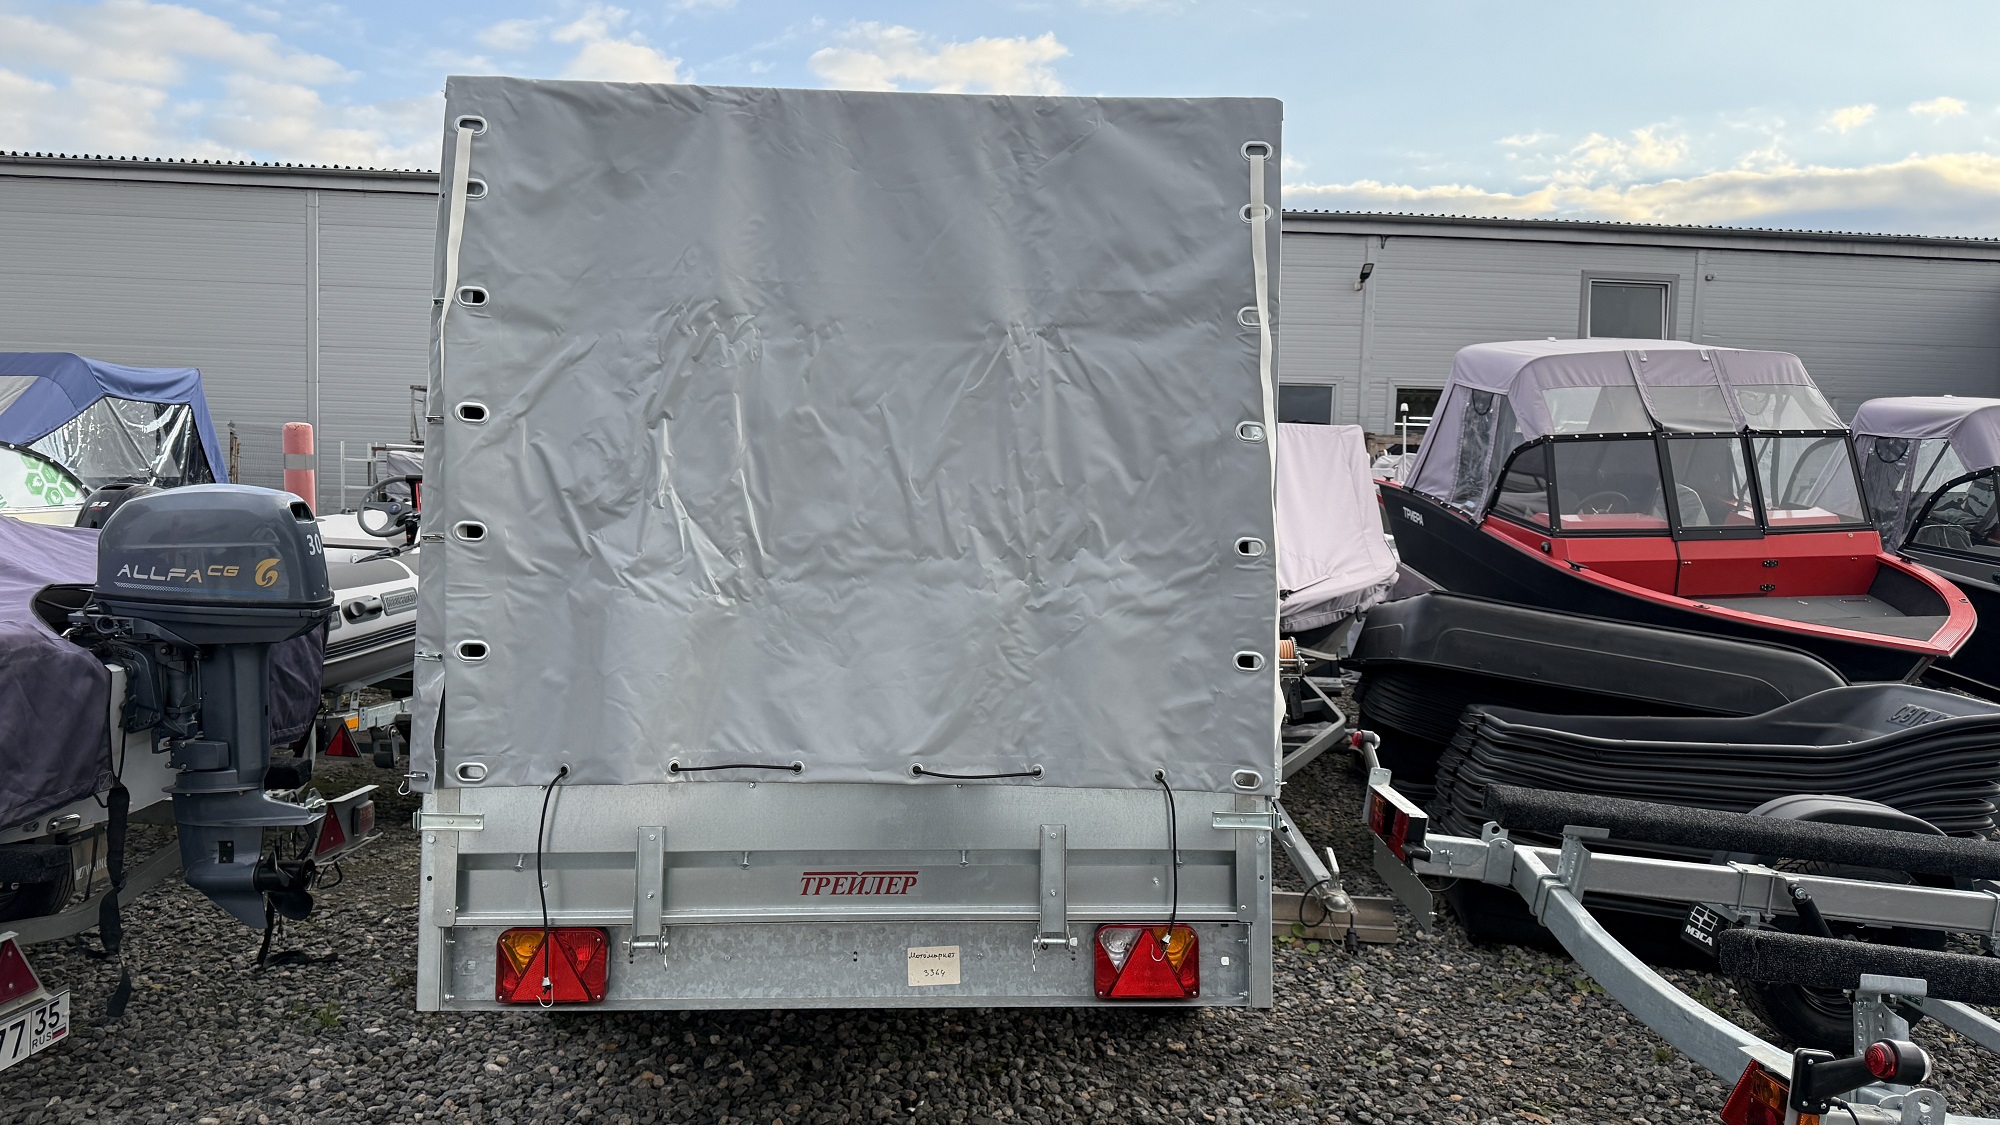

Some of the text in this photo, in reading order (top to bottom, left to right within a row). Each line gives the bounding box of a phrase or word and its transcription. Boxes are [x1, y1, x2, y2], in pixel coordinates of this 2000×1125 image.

[1403, 506, 1424, 527] ТРИЕРА
[307, 534, 322, 556] 30
[800, 871, 919, 896] ТРЕЙЛЕР
[35, 1000, 60, 1036] 35
[32, 1031, 52, 1050] RUS
